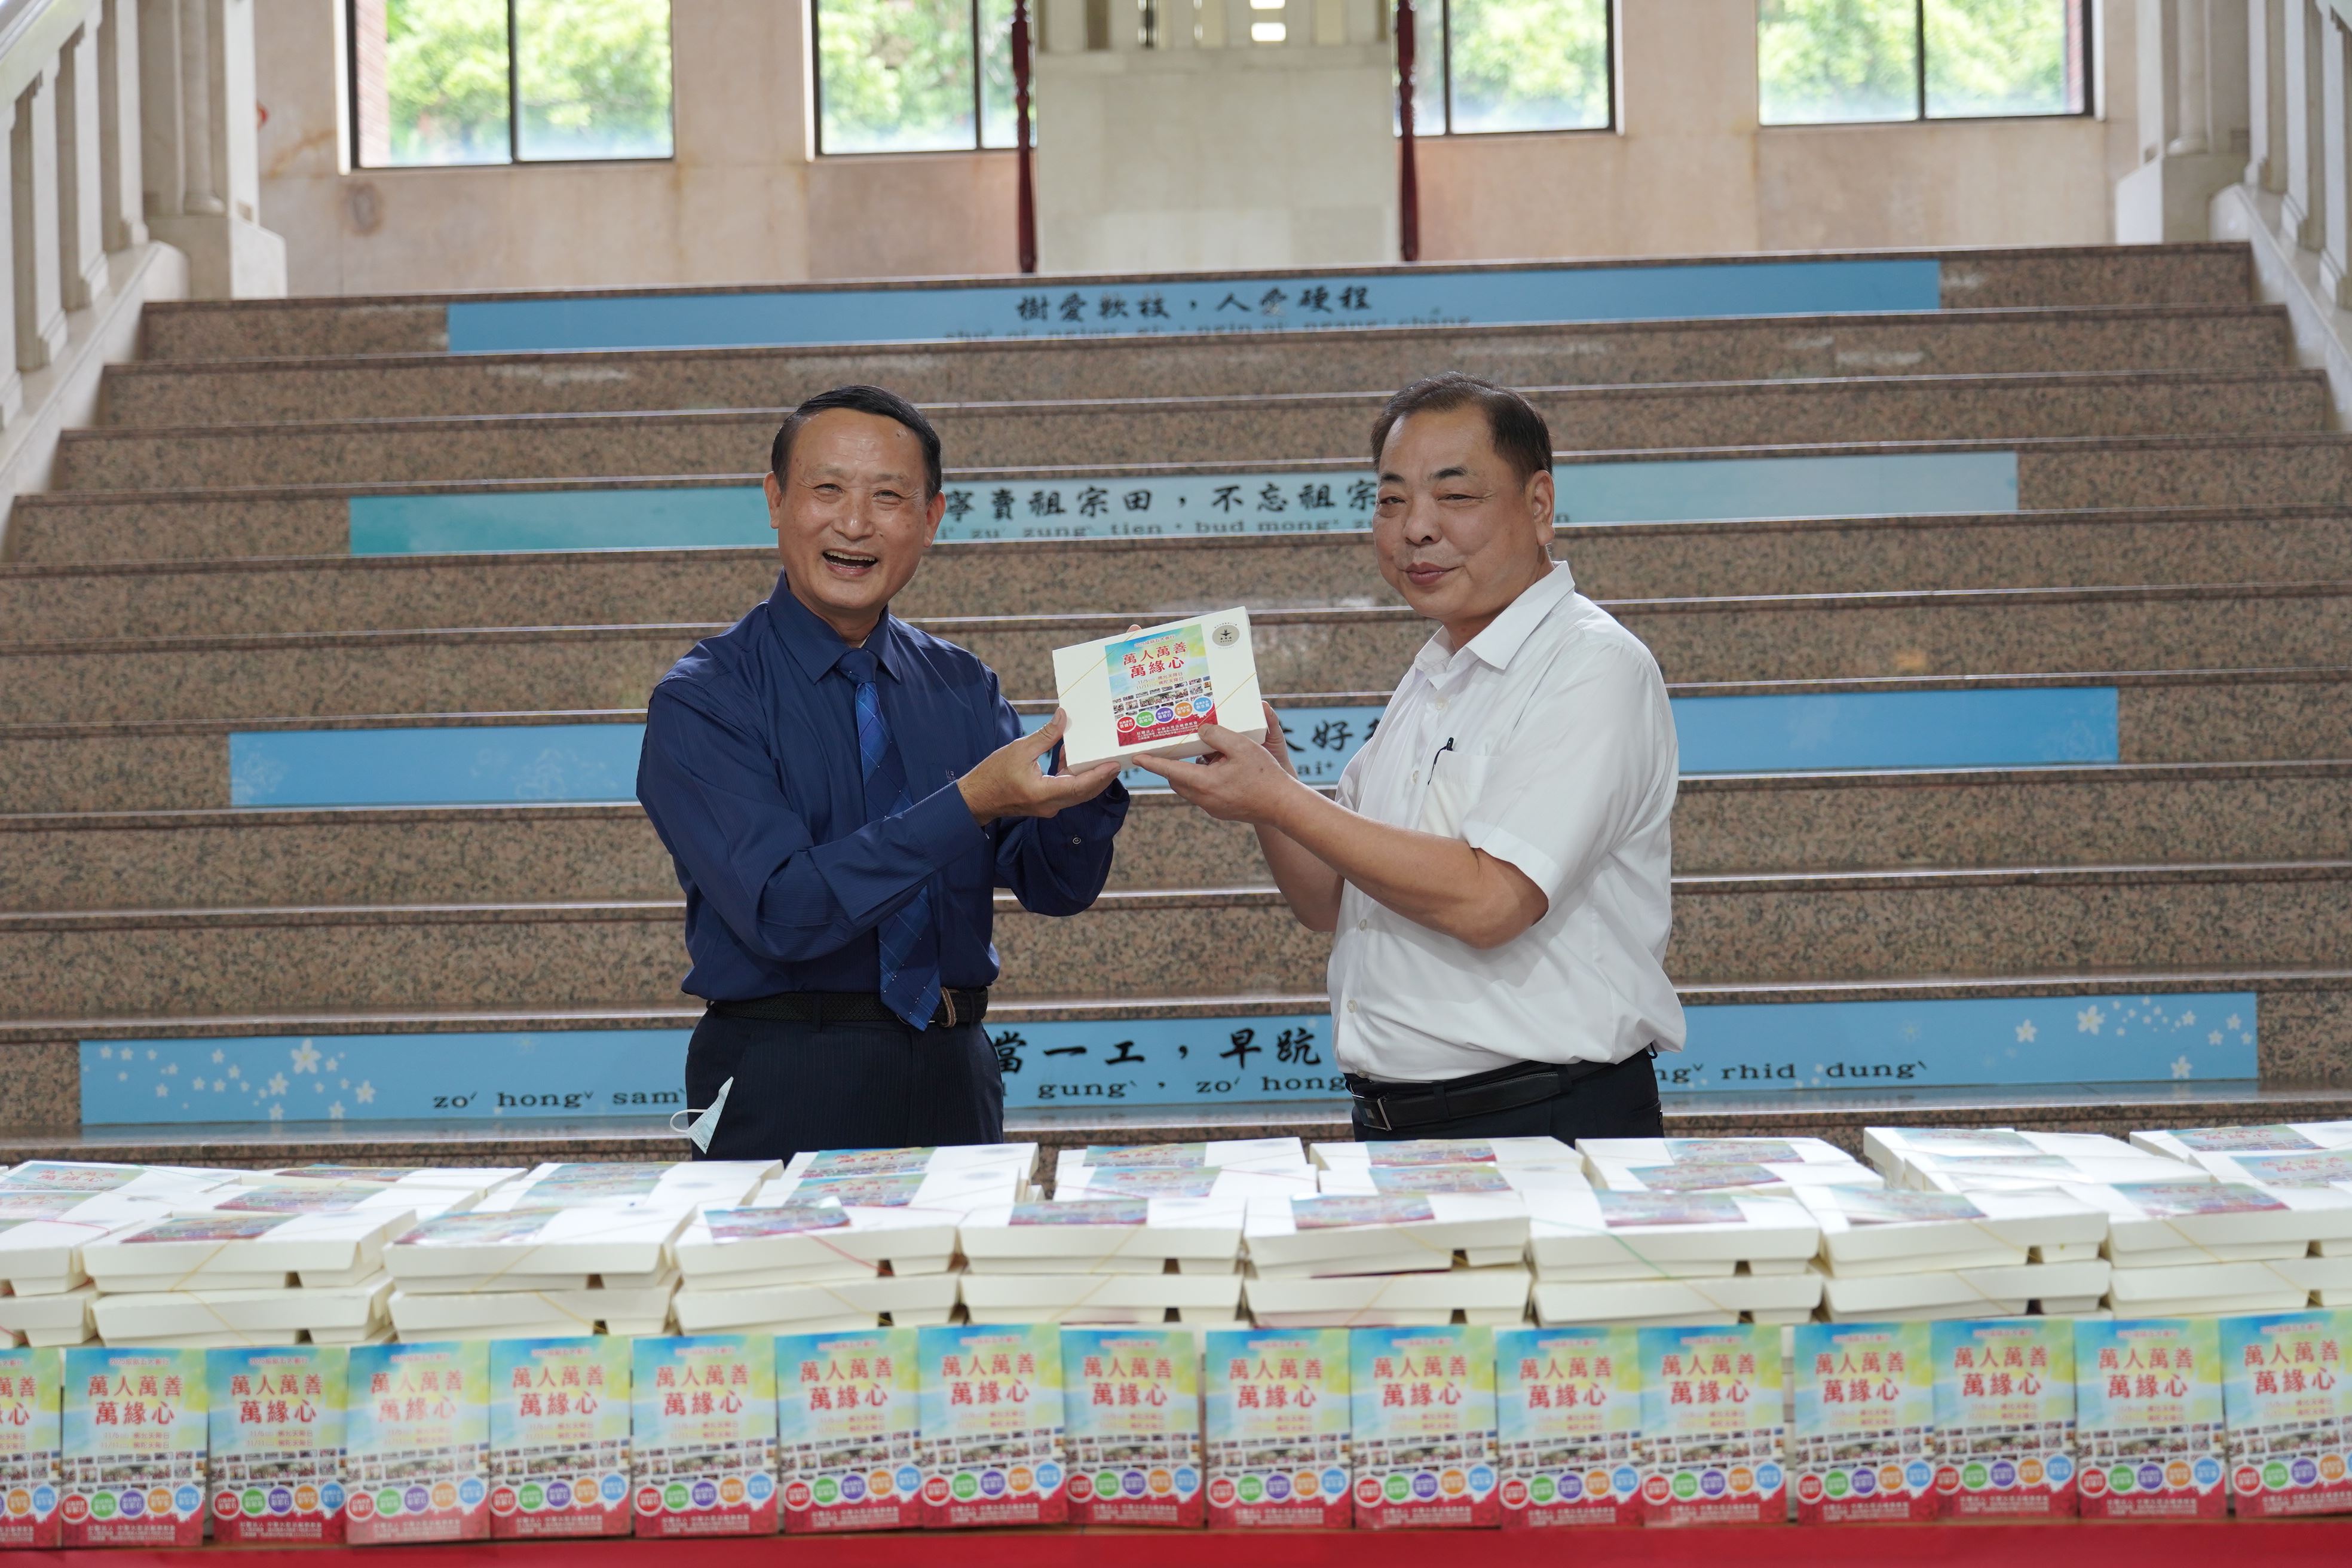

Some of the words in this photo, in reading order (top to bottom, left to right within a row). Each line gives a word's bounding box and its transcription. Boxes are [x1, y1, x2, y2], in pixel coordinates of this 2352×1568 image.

[1122, 641, 1187, 666] 萬人萬善
[1129, 656, 1184, 679] 萬緣心
[1722, 1062, 1795, 1080] rhid
[942, 1353, 1034, 1377] 萬人萬善
[1662, 1352, 1755, 1376] 萬人萬善
[1815, 1350, 1904, 1374] 萬人萬善
[1955, 1345, 2047, 1368] 萬人萬善
[2098, 1347, 2193, 1370] 萬人萬善
[2244, 1340, 2339, 1367] 萬人萬善
[512, 1365, 605, 1389] 萬人萬善
[656, 1363, 749, 1388] 萬人萬善
[800, 1356, 893, 1383] 萬人萬善
[1083, 1356, 1172, 1378] 萬人萬善
[1229, 1357, 1322, 1380] 萬人萬善
[1374, 1355, 1467, 1378] 萬人萬善
[1520, 1356, 1612, 1379] 萬人萬善
[89, 1374, 182, 1397] 萬人萬善
[230, 1374, 323, 1396] 萬人萬善
[951, 1379, 1030, 1405] 萬緣心
[1670, 1379, 1749, 1405] 萬緣心
[1823, 1377, 1900, 1404] 萬緣心
[1963, 1371, 2041, 1398] 萬緣心
[2108, 1374, 2188, 1399] 萬緣心
[2255, 1367, 2336, 1395] 萬緣心
[520, 1391, 598, 1416] 萬緣心
[664, 1389, 743, 1416] 萬緣心
[809, 1383, 888, 1410] 萬緣心
[1092, 1383, 1168, 1407] 萬緣心
[1238, 1383, 1316, 1409] 萬緣心
[1383, 1381, 1462, 1407] 萬緣心
[1528, 1382, 1607, 1409] 萬緣心
[96, 1399, 174, 1425] 萬緣心
[240, 1399, 316, 1425] 萬緣心
